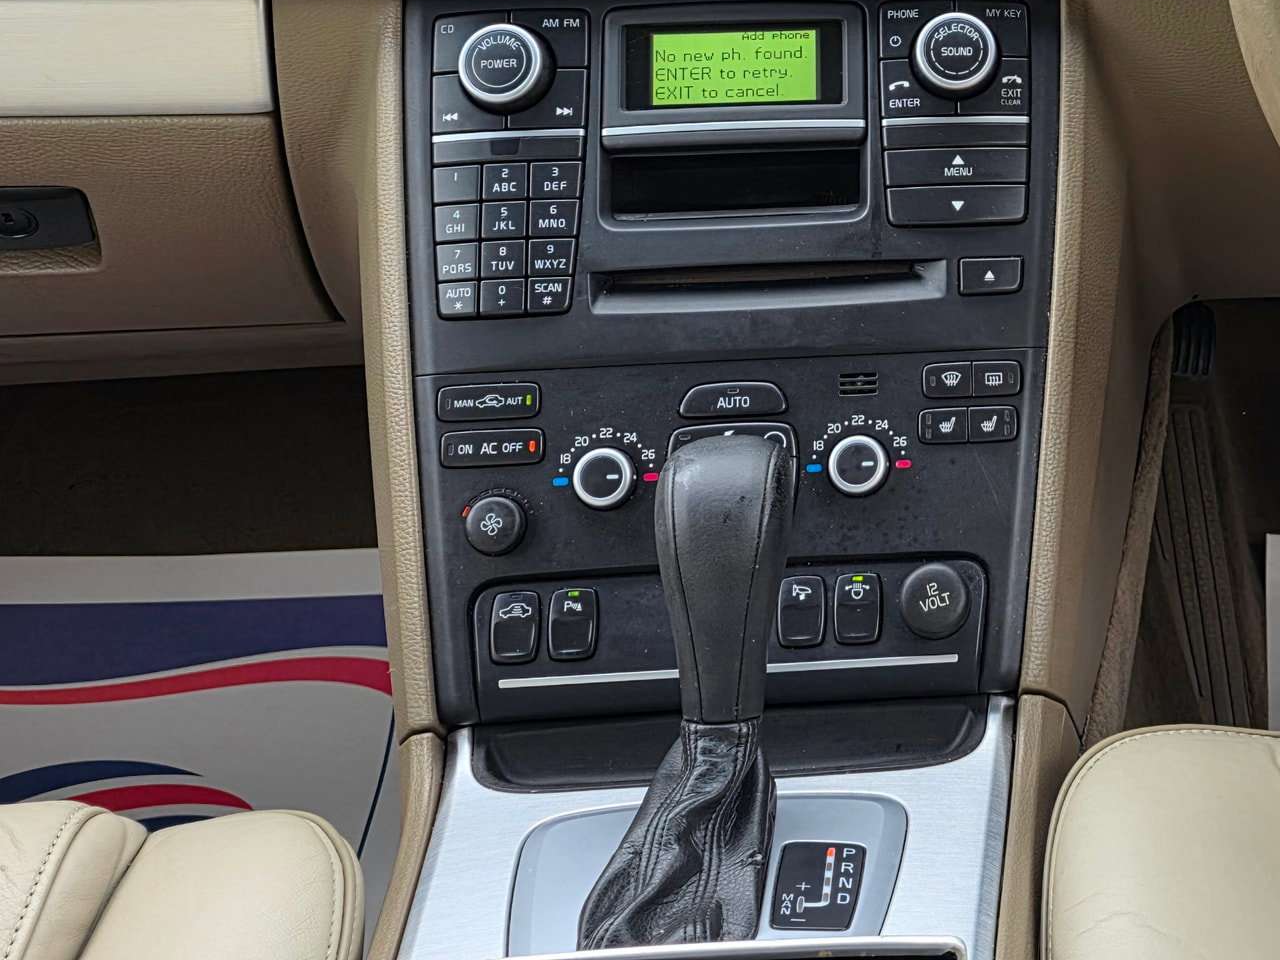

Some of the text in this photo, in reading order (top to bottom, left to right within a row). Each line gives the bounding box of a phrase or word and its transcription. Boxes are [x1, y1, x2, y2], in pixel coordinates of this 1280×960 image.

[887, 9, 919, 19] PHONE
[986, 9, 1022, 18] MY KEY
[542, 18, 580, 28] AM FM
[440, 25, 454, 34] CD
[934, 23, 980, 41] SELECTOR
[742, 32, 765, 41] Add
[478, 35, 521, 50] VOLUME
[655, 49, 676, 63] No
[683, 52, 714, 62] new
[941, 47, 973, 56] SOUND
[480, 58, 517, 69] POWER
[655, 67, 712, 81] ENTER
[720, 69, 736, 79] to
[655, 86, 693, 100] EXIT
[702, 88, 718, 98] to
[1001, 89, 1022, 97] EXIT
[889, 99, 920, 108] ENTER
[454, 172, 458, 181] 1
[501, 168, 508, 178] 2
[552, 167, 559, 177] 3
[944, 167, 973, 176] MENU
[492, 182, 517, 192] ABC
[544, 181, 567, 191] DEF
[453, 210, 460, 220] 4
[500, 207, 508, 217] 5
[550, 205, 557, 215] 6
[445, 223, 465, 234] GHI
[492, 220, 516, 231] JKL
[538, 218, 566, 228] MNO
[454, 249, 461, 259] 7
[499, 247, 507, 256] 8
[547, 245, 554, 254] 9
[442, 263, 472, 274] PQRS
[491, 261, 514, 271] TUV
[534, 258, 567, 270] WXYZ
[446, 288, 471, 298] AUTO
[498, 285, 506, 295] 0
[534, 283, 562, 293] SCAN
[453, 396, 523, 408] MAN AUT
[717, 396, 750, 409] AUTO
[851, 415, 864, 425] 22
[875, 419, 889, 430] 24
[599, 427, 613, 438] 22
[827, 423, 841, 434] 20
[575, 435, 589, 447] 20
[623, 432, 637, 443] 24
[893, 436, 907, 447] 26
[457, 442, 523, 455] ON AC OFF
[813, 440, 824, 451] 18
[560, 453, 571, 464] 18
[641, 449, 655, 460] 26
[926, 582, 938, 597] 12
[919, 592, 951, 612] VOLT
[843, 848, 856, 858] P
[841, 862, 854, 873] R
[838, 877, 853, 889] N
[780, 893, 794, 915] MAN
[837, 893, 850, 904] D
